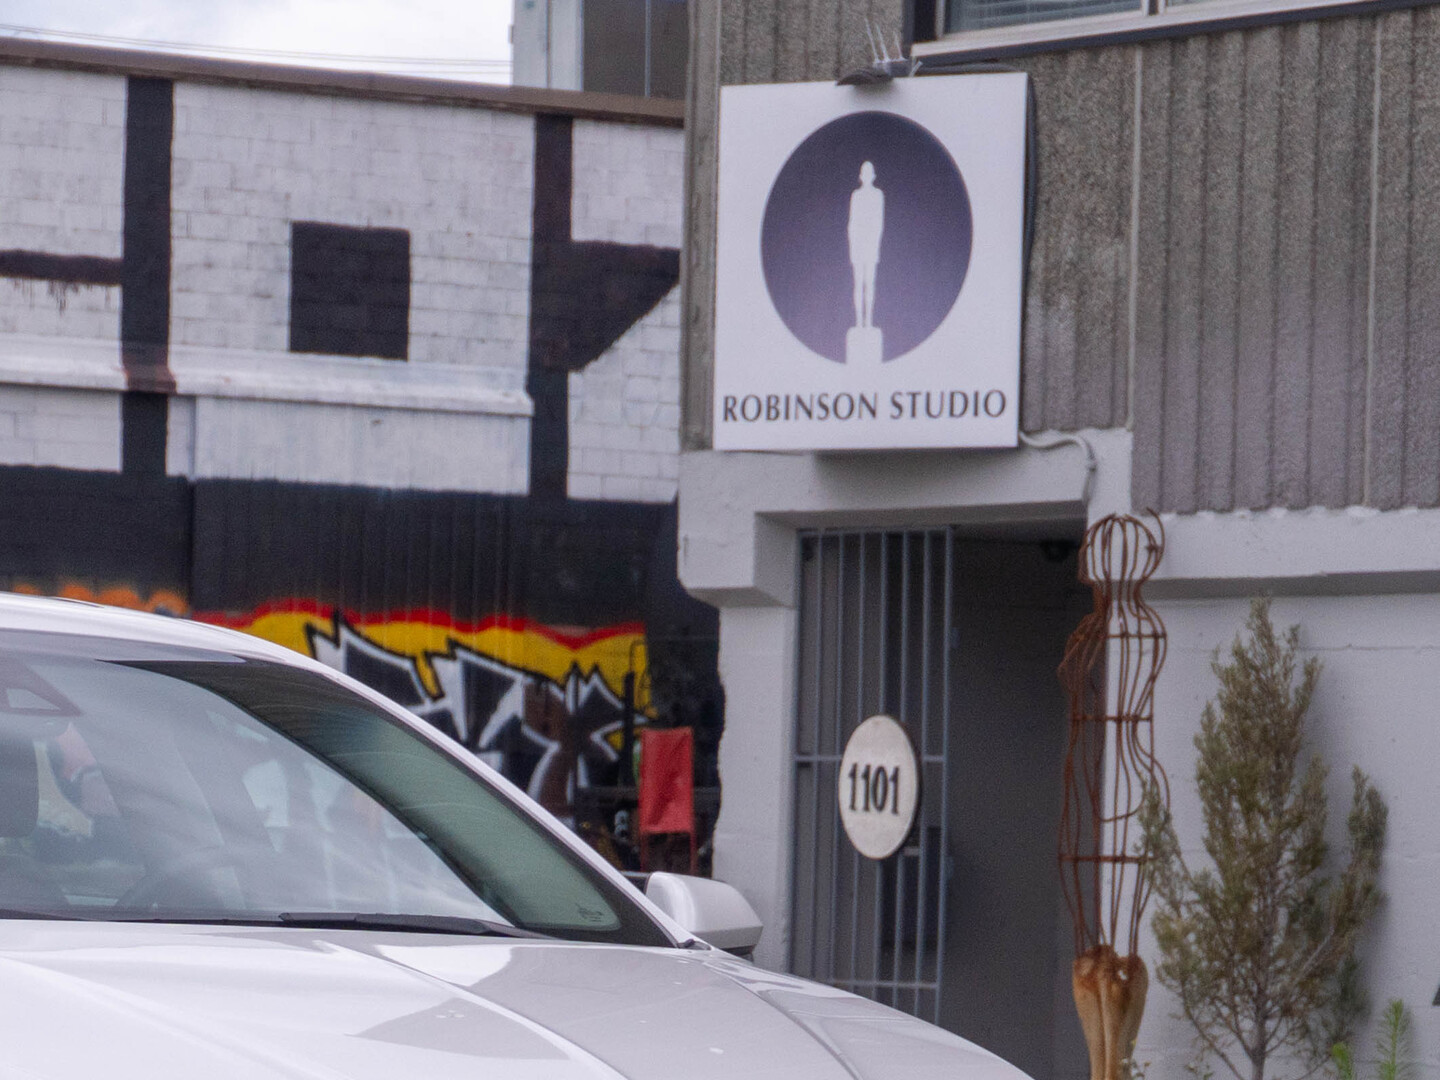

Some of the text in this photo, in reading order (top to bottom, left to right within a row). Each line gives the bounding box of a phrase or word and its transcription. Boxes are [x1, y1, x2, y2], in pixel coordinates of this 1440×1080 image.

[722, 389, 1007, 422] ROBINSON STUDIO
[848, 762, 900, 816] 1101
